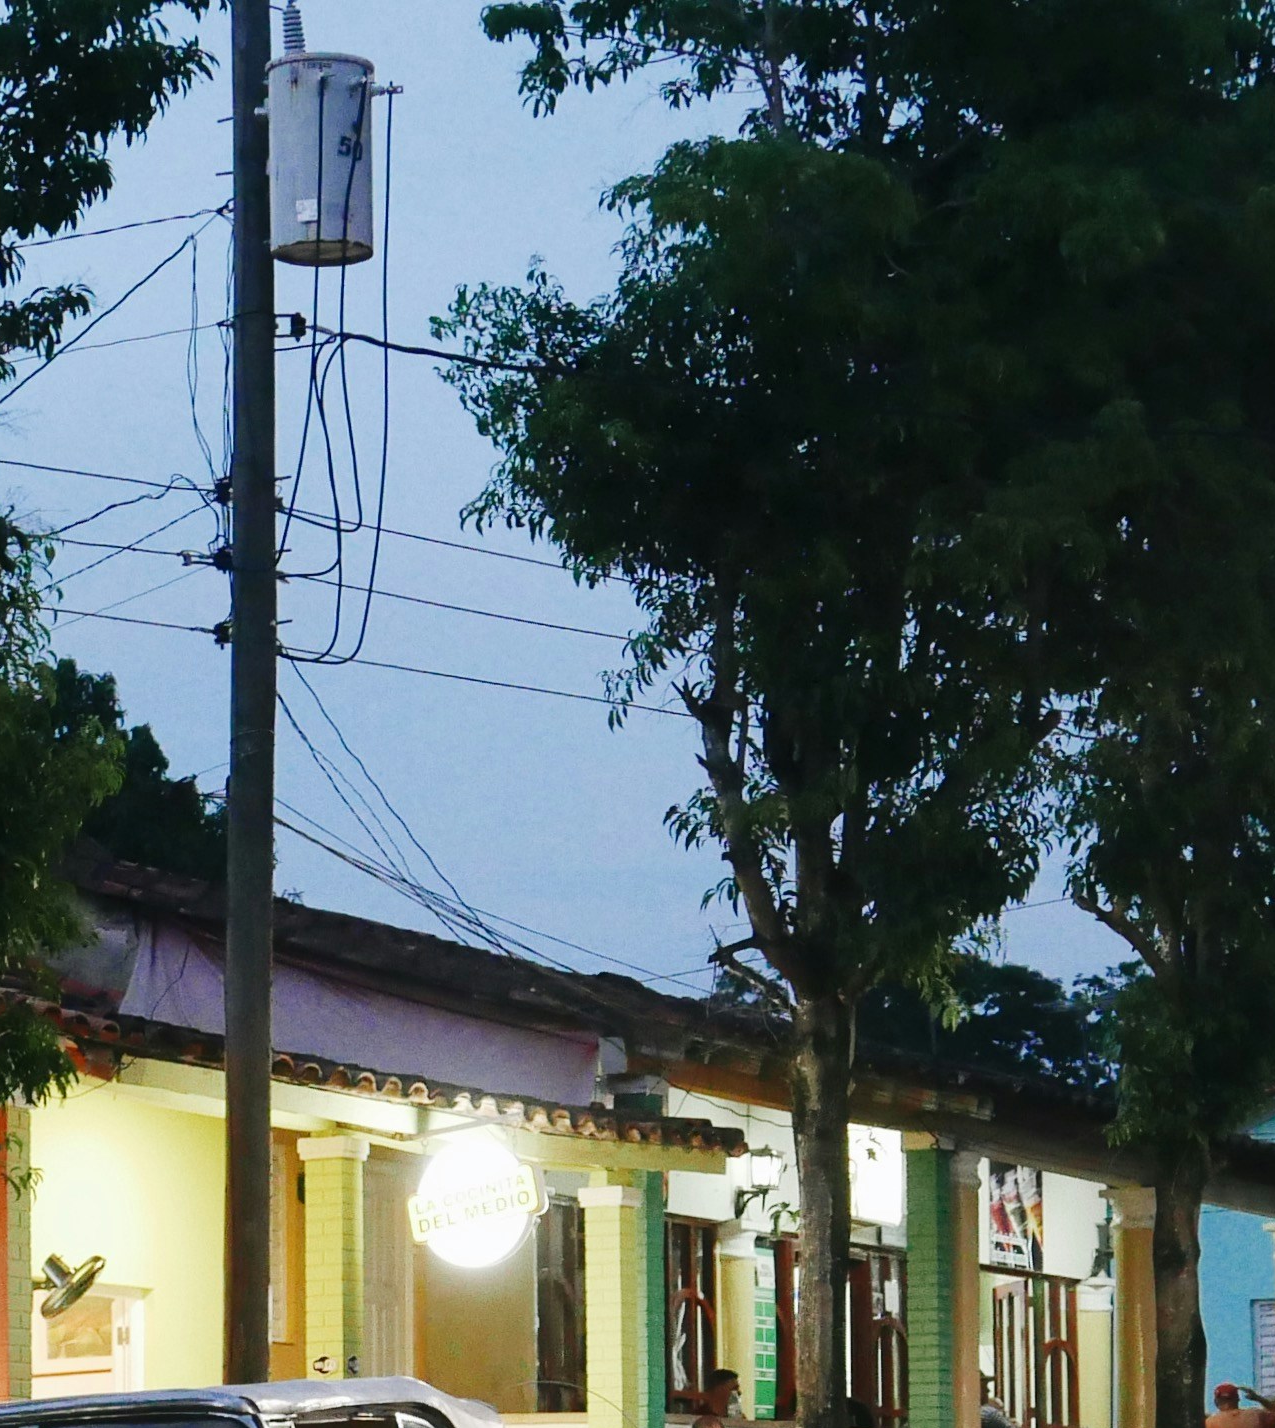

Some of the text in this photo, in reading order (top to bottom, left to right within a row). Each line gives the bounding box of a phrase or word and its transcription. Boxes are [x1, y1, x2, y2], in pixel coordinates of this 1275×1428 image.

[415, 1199, 437, 1216] LA
[418, 1190, 530, 1234] DEL MEDIO
